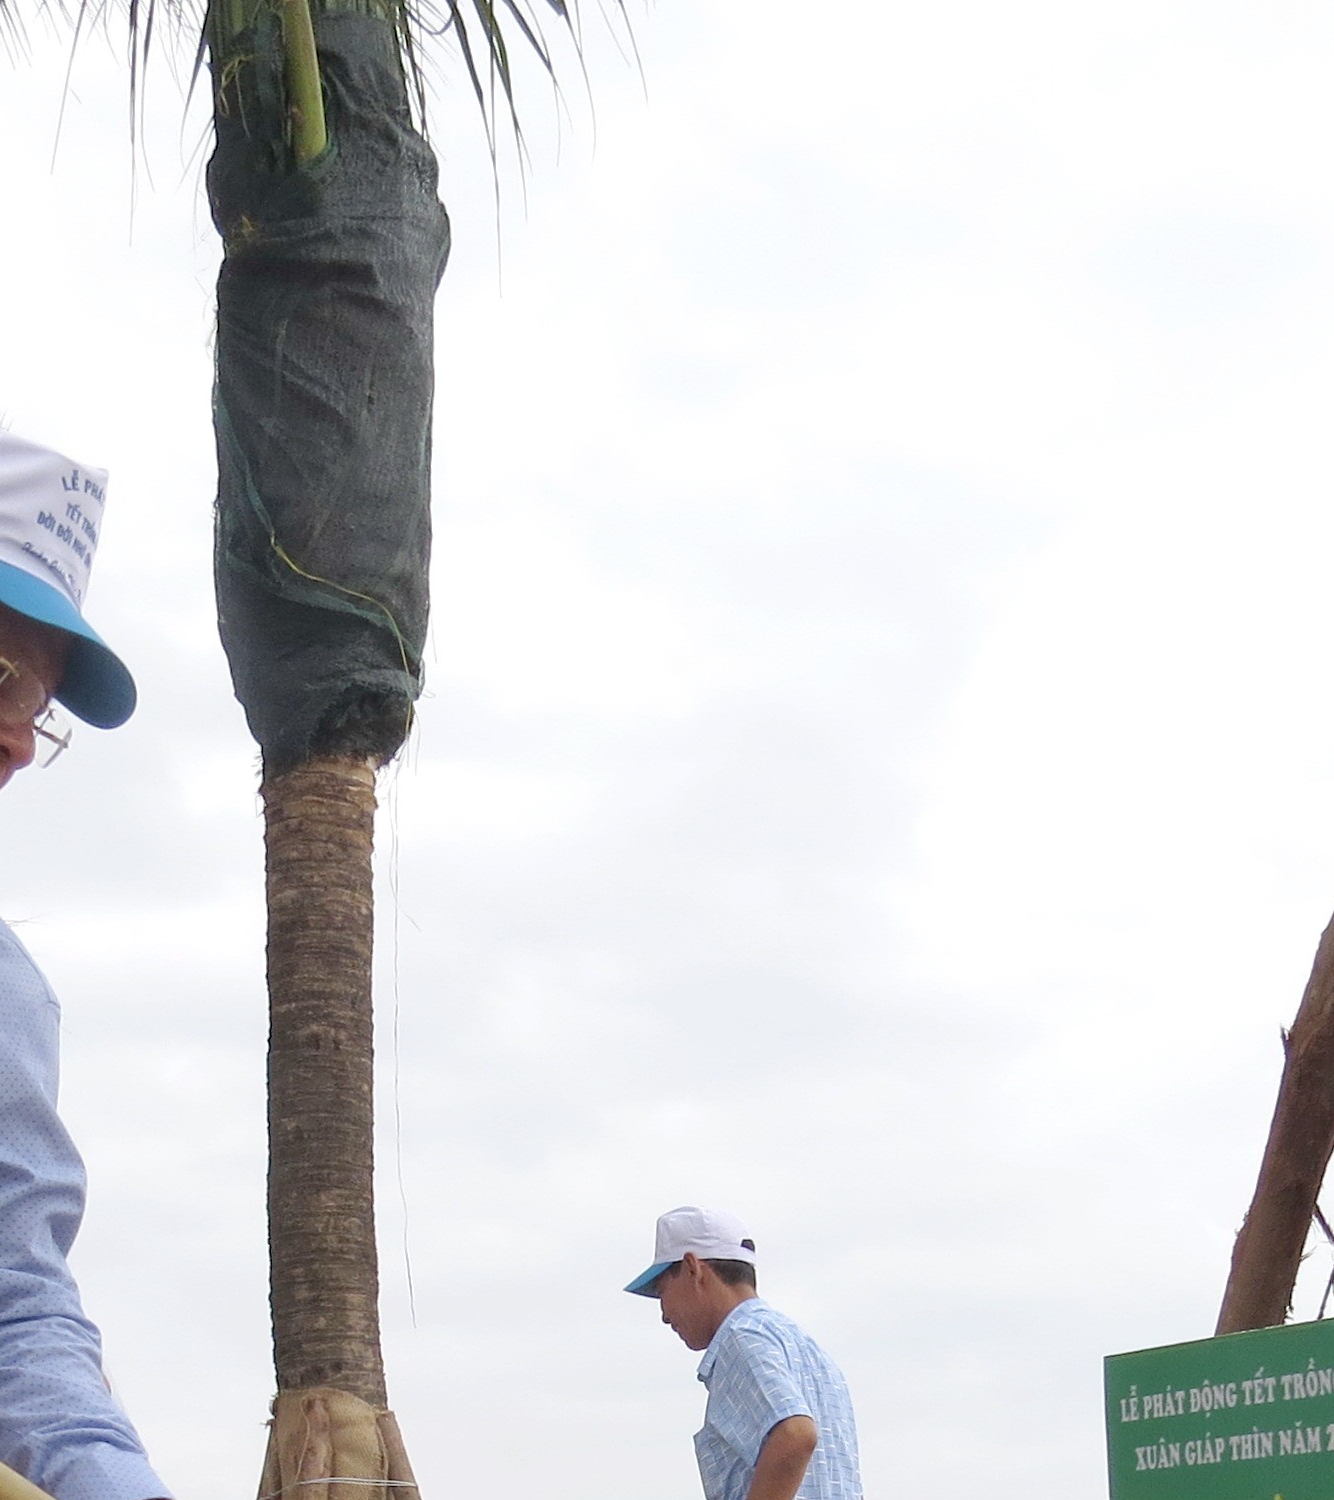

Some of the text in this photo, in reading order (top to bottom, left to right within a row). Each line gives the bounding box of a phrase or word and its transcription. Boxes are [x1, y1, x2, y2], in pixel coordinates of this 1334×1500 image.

[1120, 1384, 1139, 1423] LỄ
[1143, 1384, 1186, 1419] PHÁT
[1189, 1379, 1238, 1418] ĐỘNG
[1241, 1366, 1277, 1406] TẾT
[1135, 1437, 1181, 1471] XUÂN
[1184, 1431, 1226, 1466] GIÁP
[1229, 1425, 1274, 1461] THÌN
[1278, 1420, 1322, 1456] NĂM
